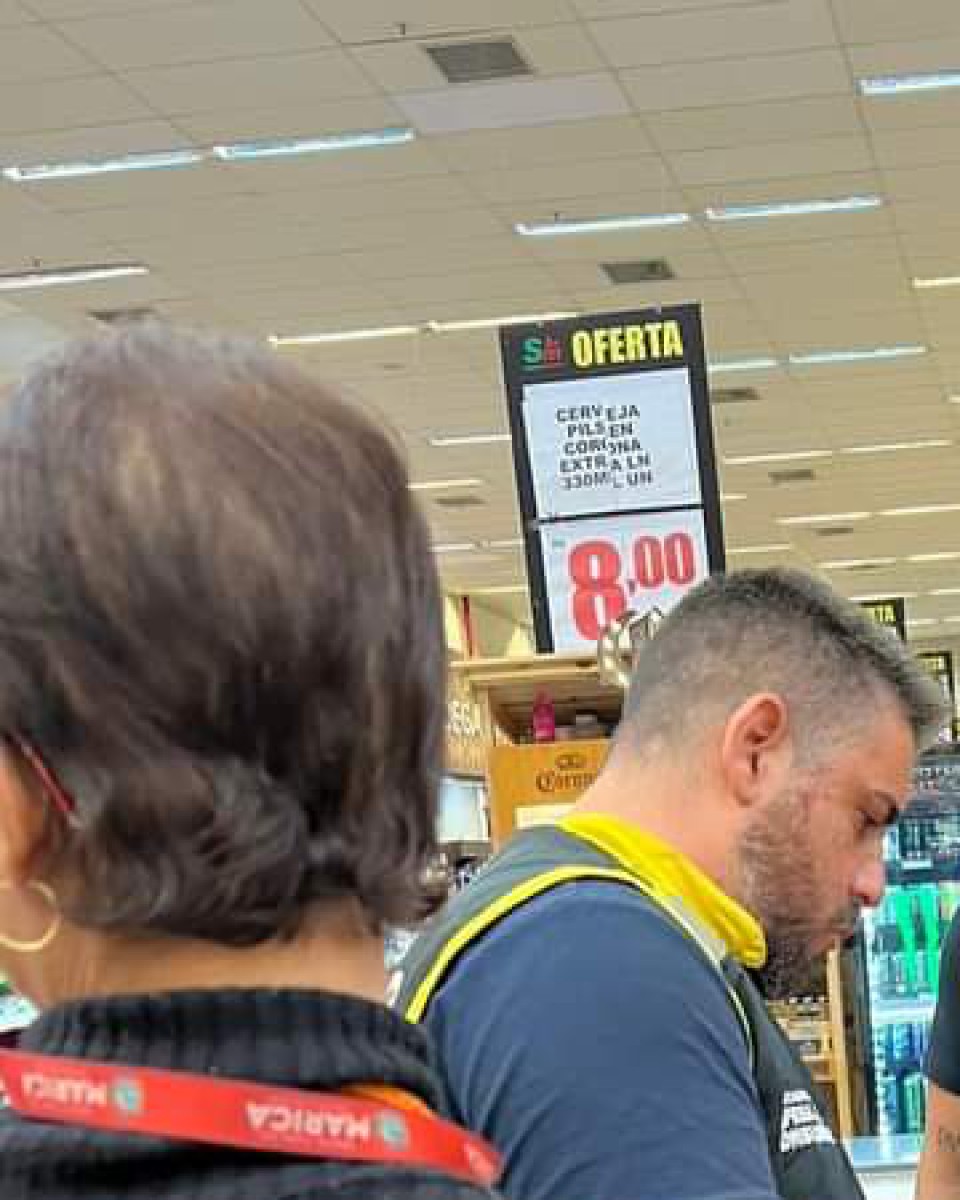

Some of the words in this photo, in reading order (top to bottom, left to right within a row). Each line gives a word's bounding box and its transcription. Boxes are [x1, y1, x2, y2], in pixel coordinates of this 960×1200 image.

[570, 320, 684, 368] OFERTA
[556, 404, 641, 422] CERVEJA
[567, 422, 634, 438] PILSEN
[563, 438, 643, 456] CORONA
[559, 455, 622, 473] EXTRA
[569, 531, 696, 641] 8,00
